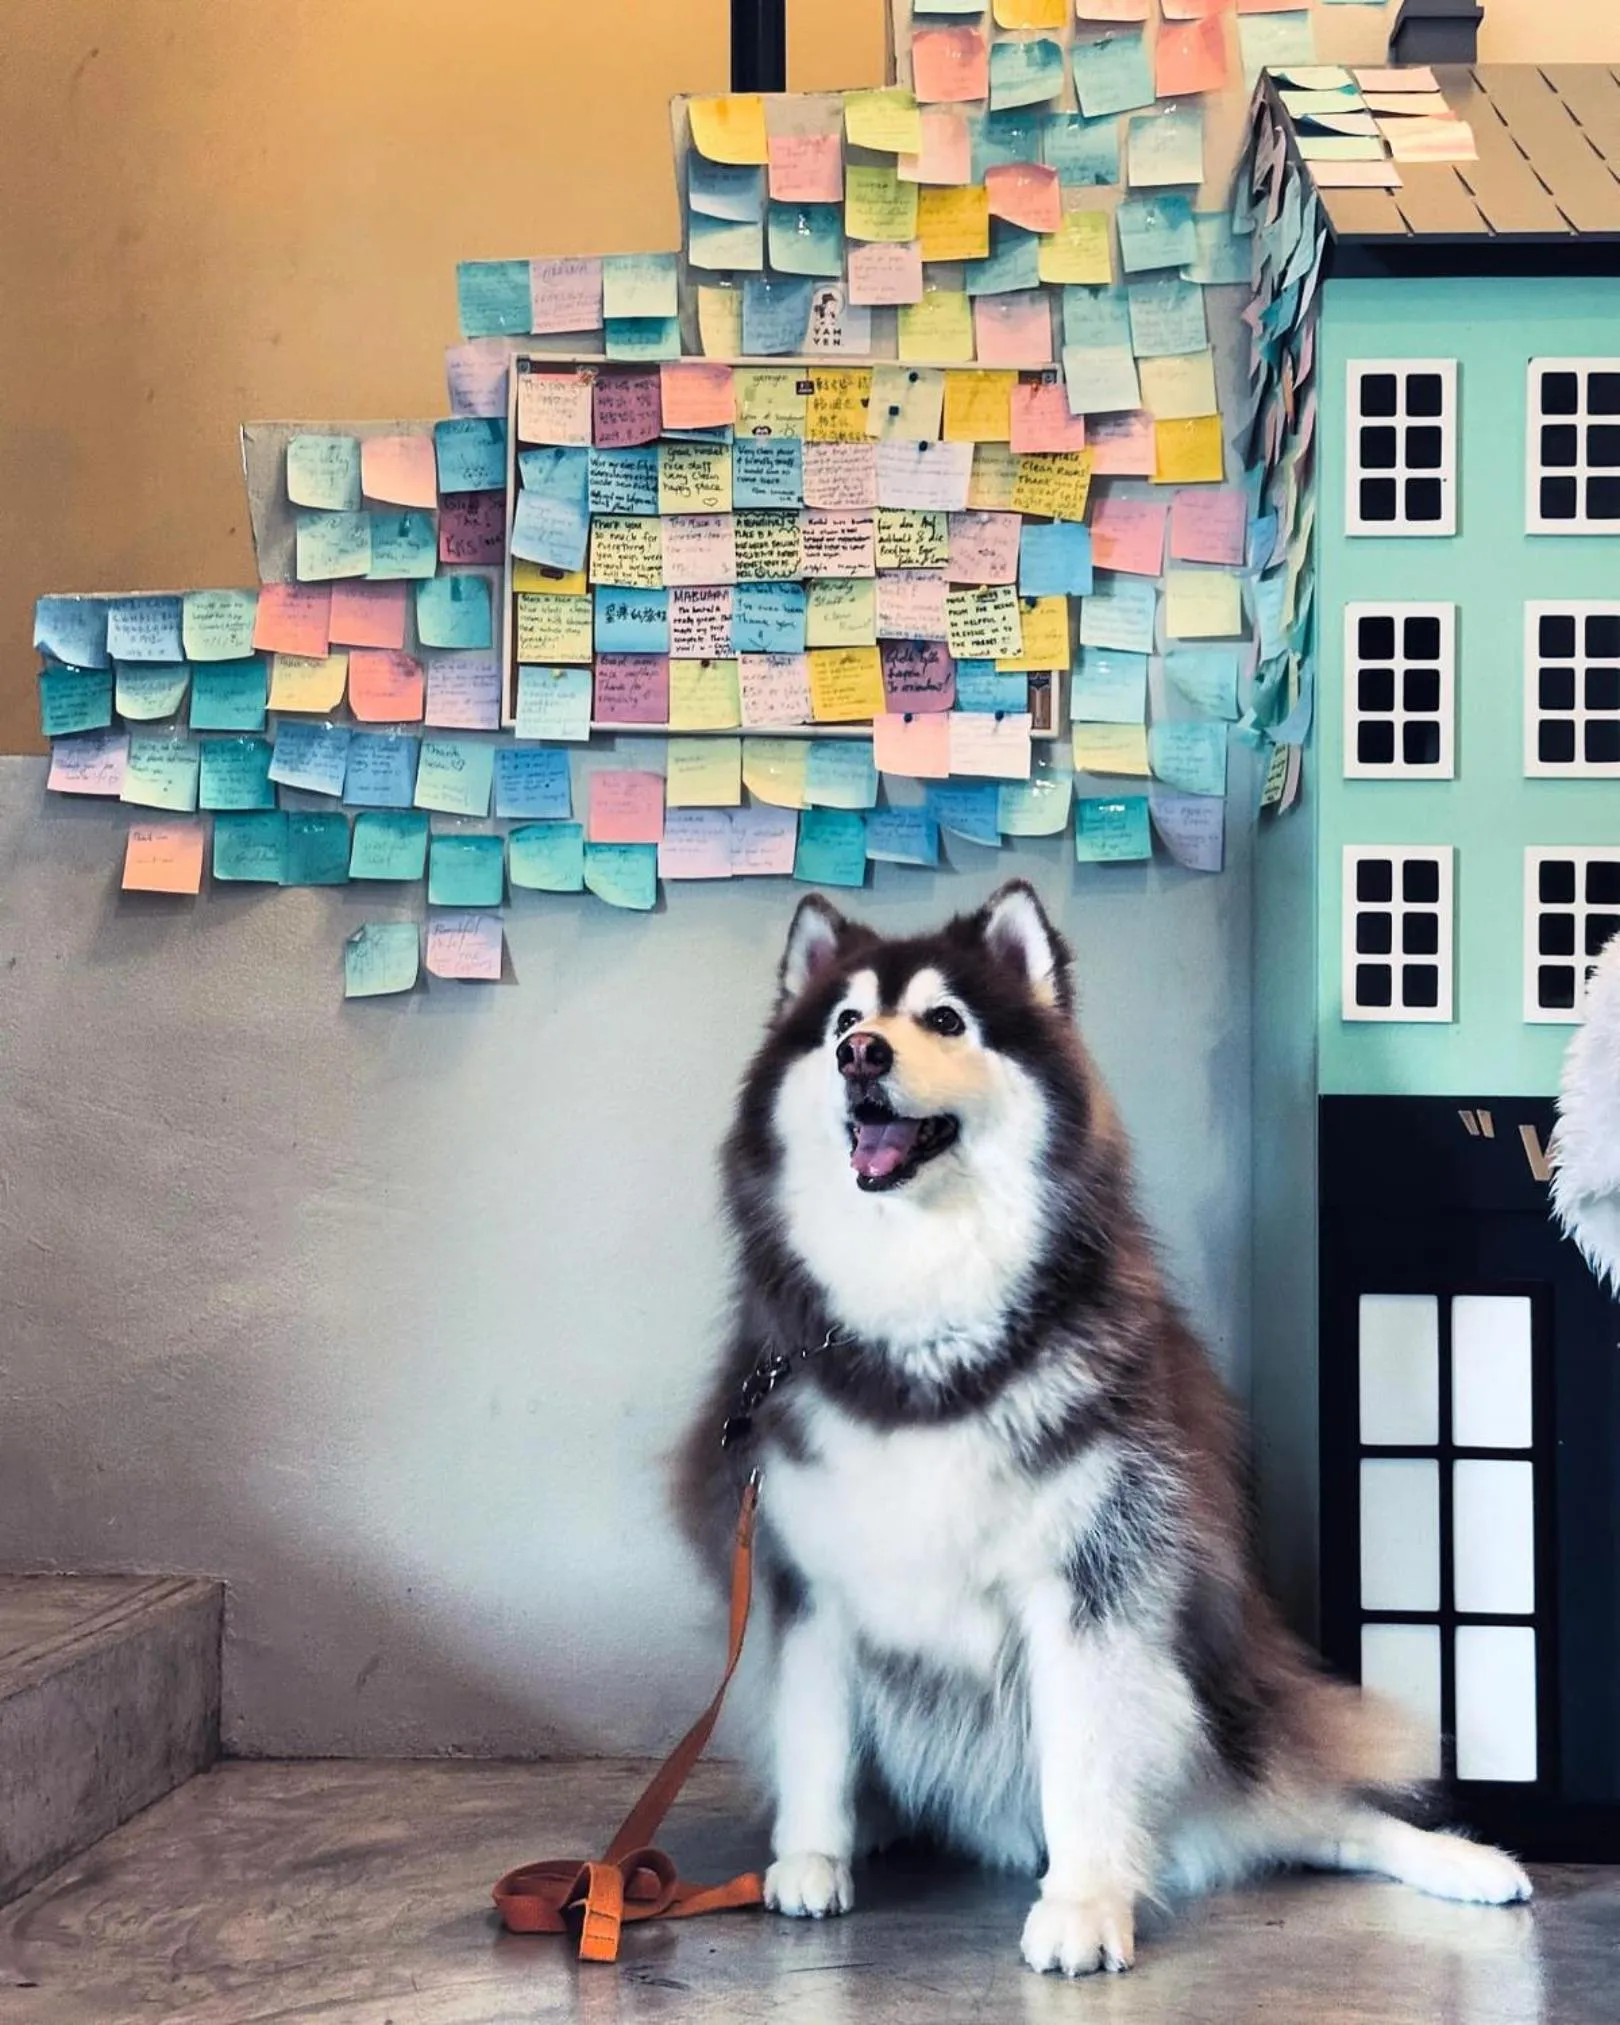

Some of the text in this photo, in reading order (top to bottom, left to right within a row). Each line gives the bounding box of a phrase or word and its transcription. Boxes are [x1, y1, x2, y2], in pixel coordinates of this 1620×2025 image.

[813, 328, 842, 336] YAM
[688, 460, 711, 473] staff
[1018, 474, 1049, 485] Thank
[609, 532, 637, 541] much
[643, 531, 658, 542] for
[963, 617, 996, 626] HELPFUL
